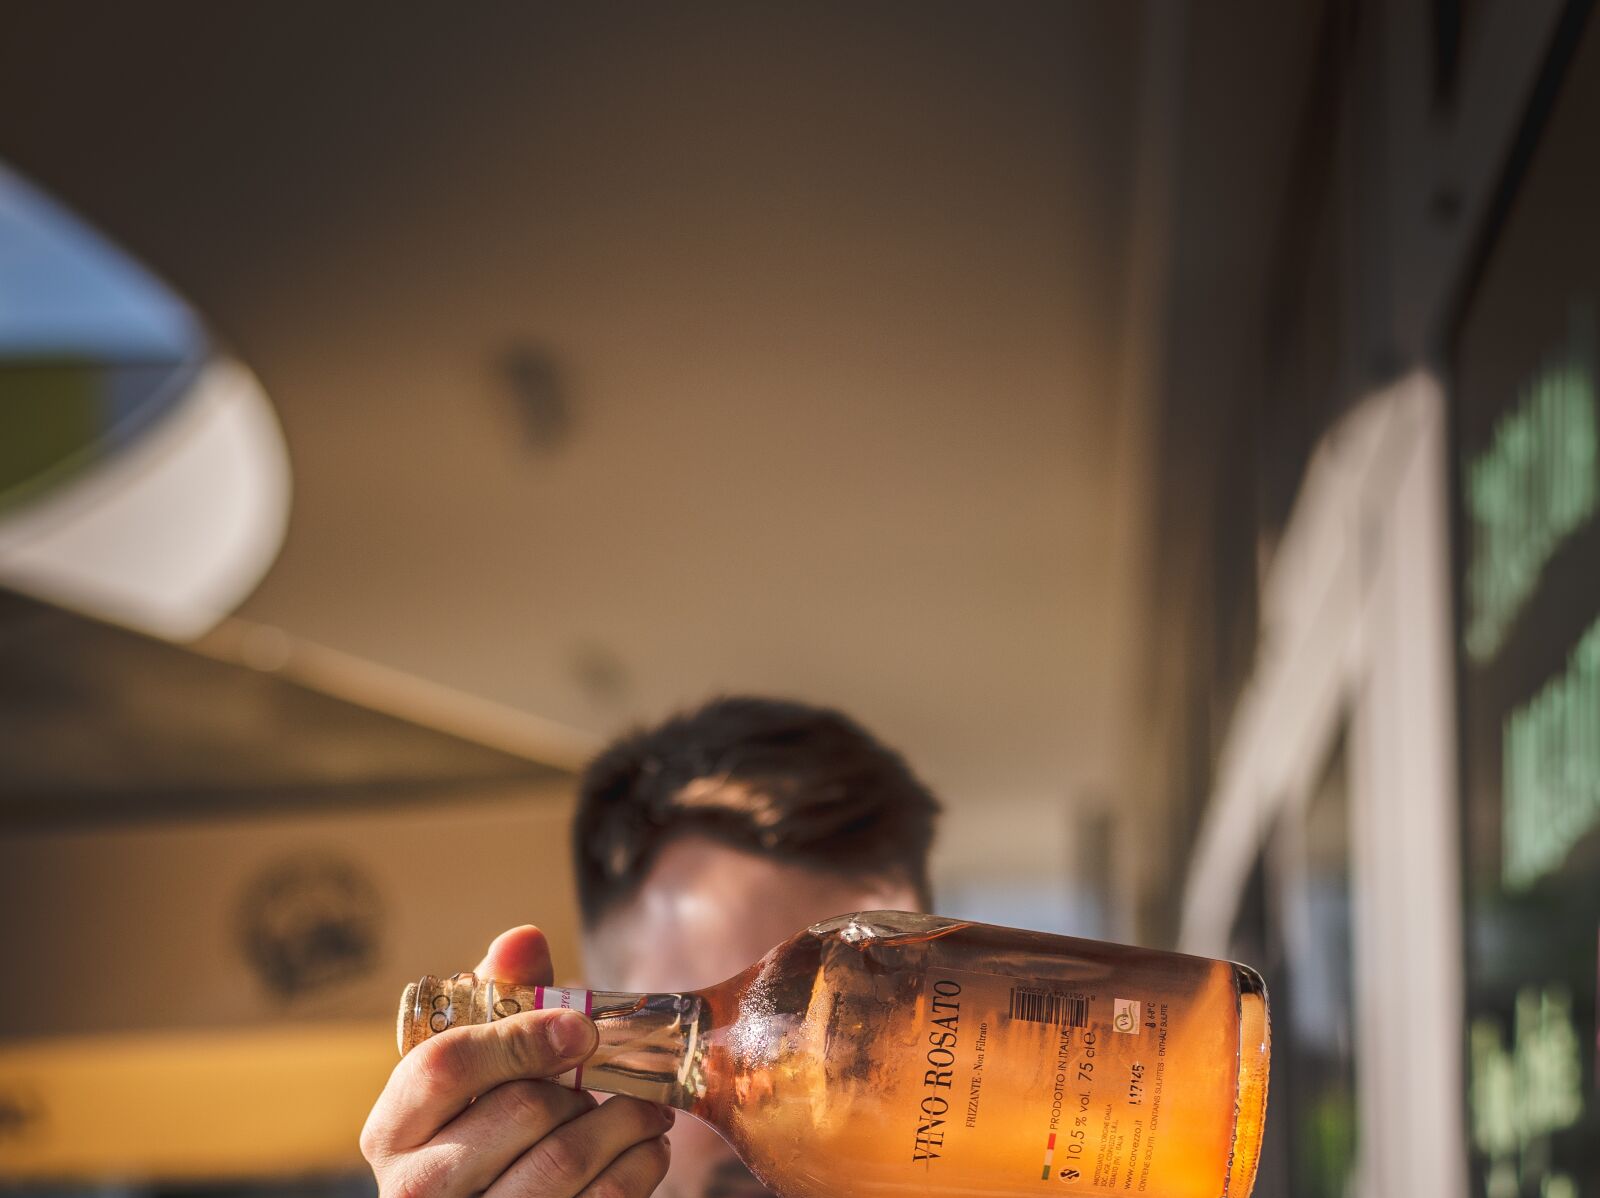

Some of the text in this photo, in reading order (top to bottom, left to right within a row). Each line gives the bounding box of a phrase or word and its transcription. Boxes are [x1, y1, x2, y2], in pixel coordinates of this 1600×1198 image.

[975, 1022, 988, 1052] Filtrato
[912, 980, 962, 1163] VINO ROSATO
[972, 1054, 985, 1071] Non
[1077, 1062, 1094, 1082] 75
[1049, 1030, 1069, 1130] PRODOTTO IN ITALIA
[965, 1076, 982, 1129] FRIZZANTE
[1079, 1091, 1091, 1113] vol.
[1149, 1096, 1161, 1131] CONTAINS
[1074, 1116, 1087, 1127] %
[1066, 1130, 1085, 1160] 10,5
[1124, 1119, 1143, 1190] www.corvezzo.it
